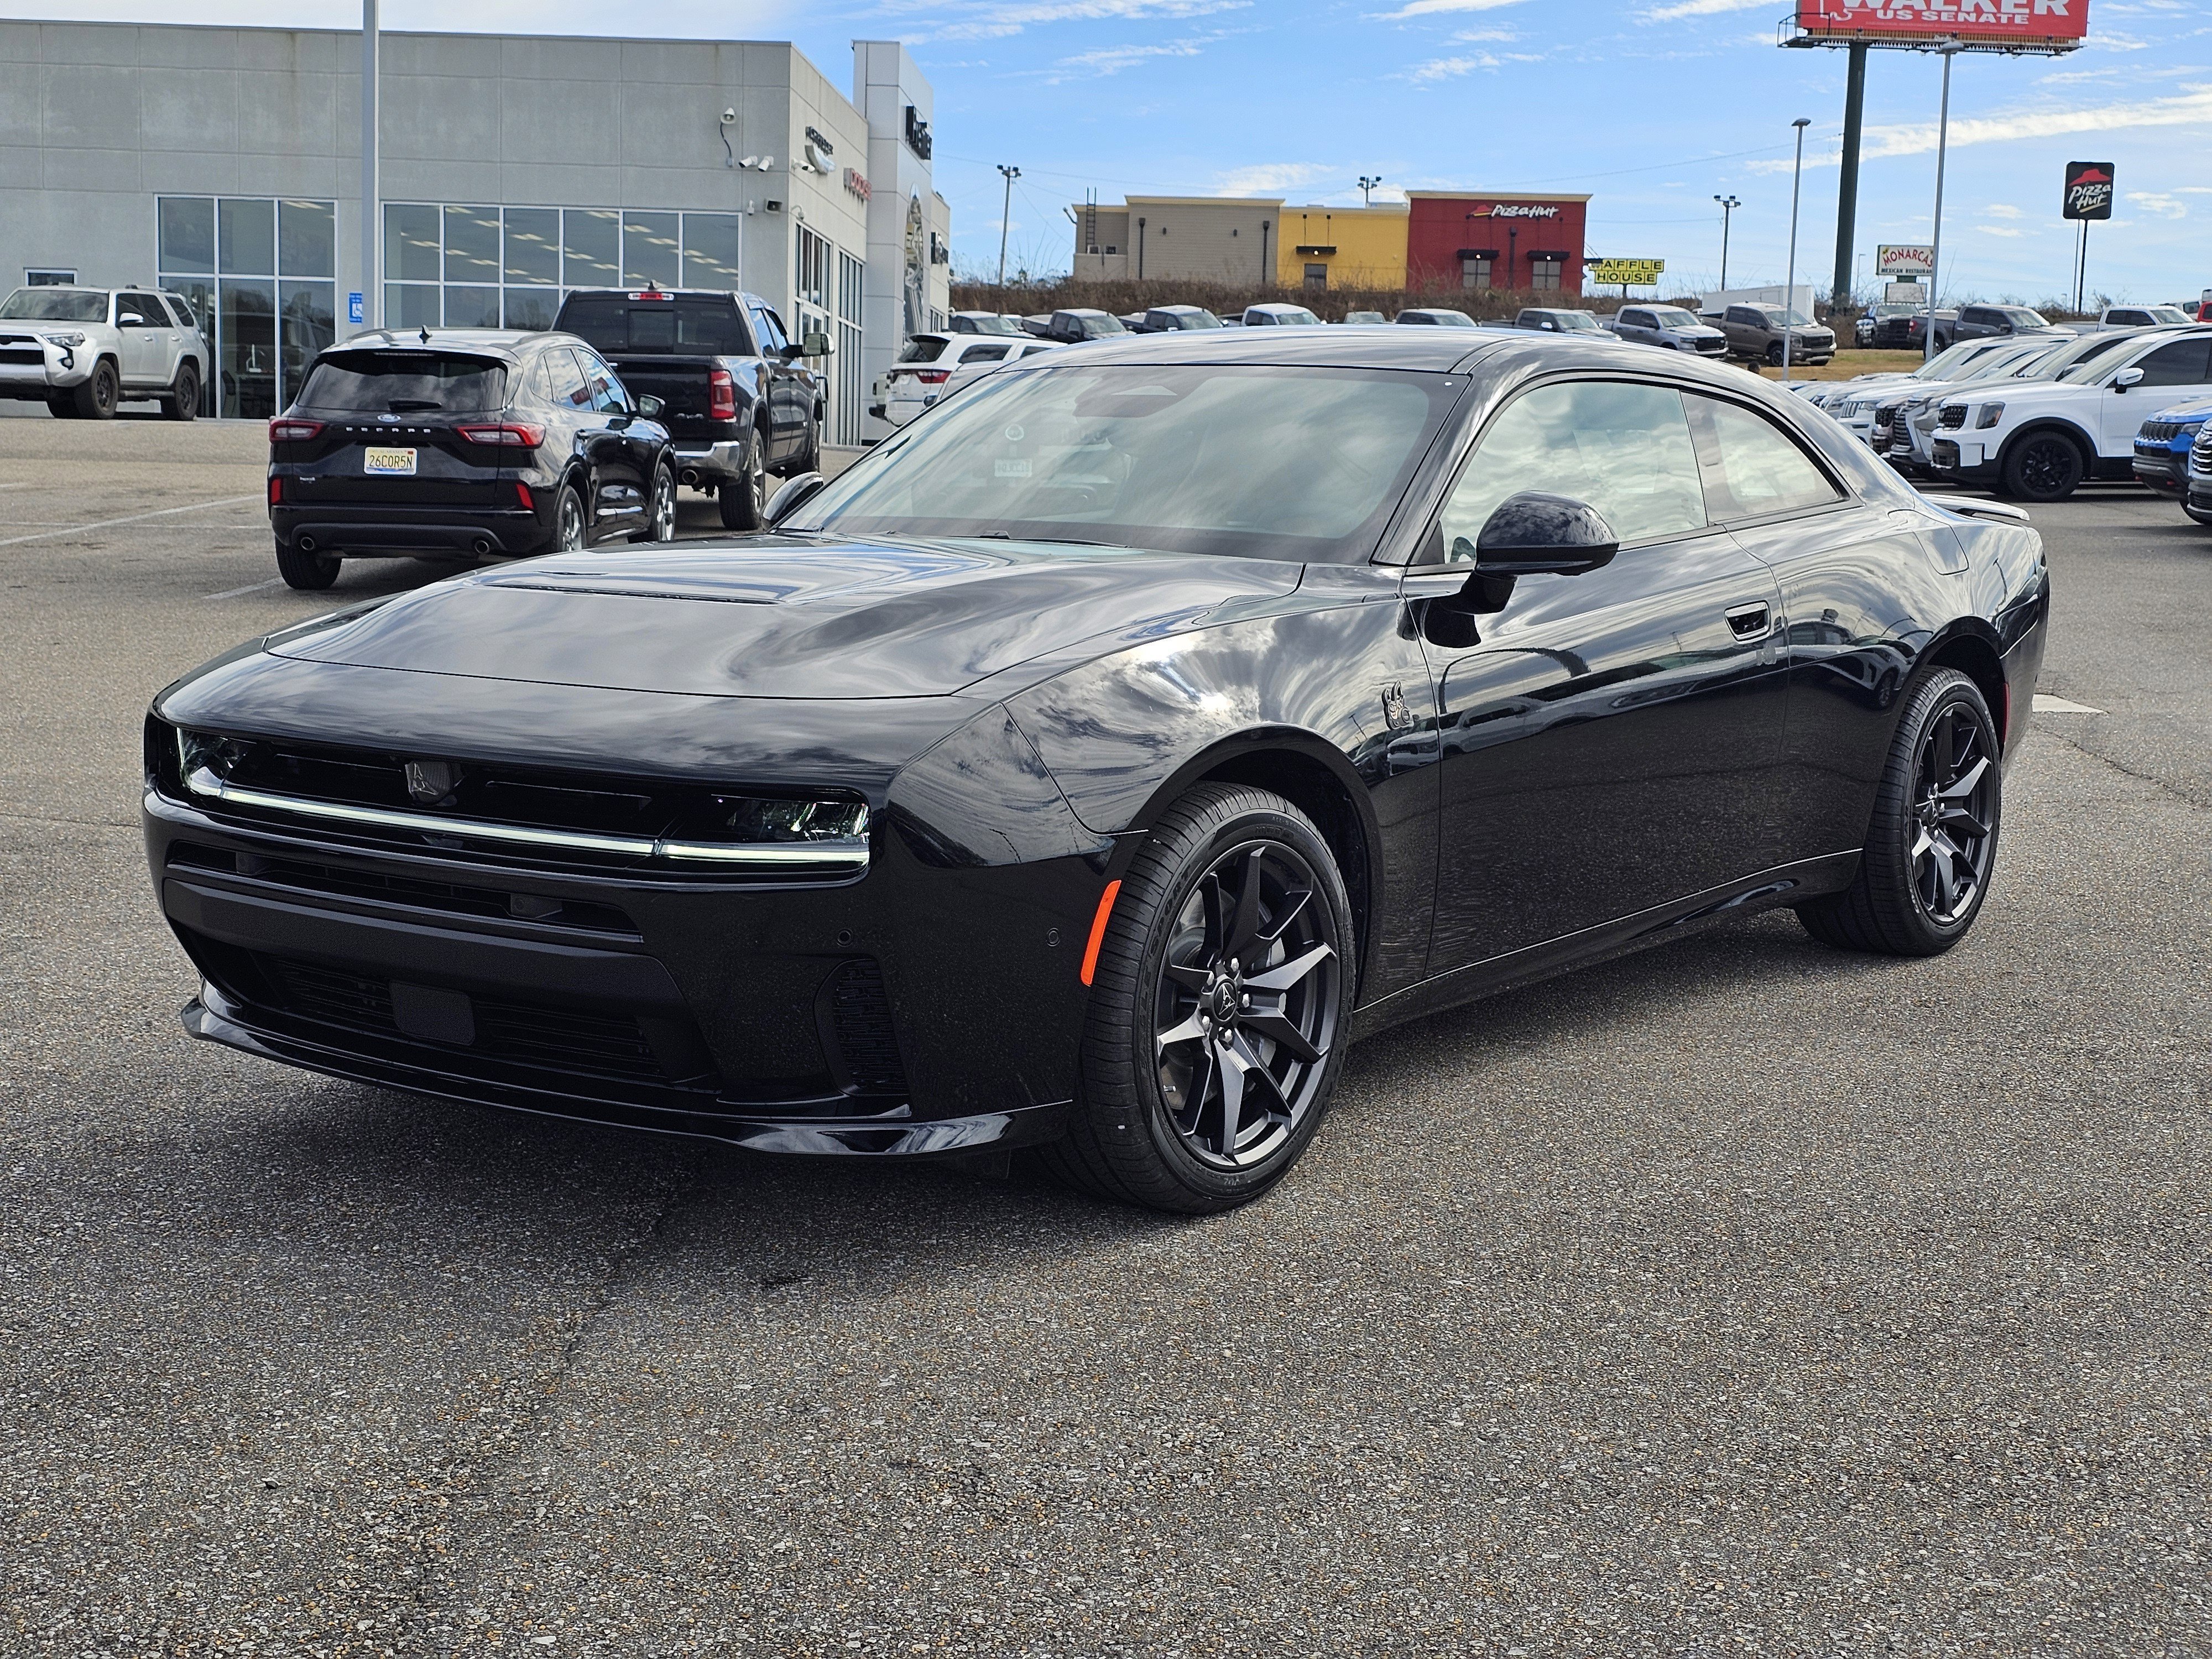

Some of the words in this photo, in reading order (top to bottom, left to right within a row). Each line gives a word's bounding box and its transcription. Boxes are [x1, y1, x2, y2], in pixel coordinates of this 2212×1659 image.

[1843, 0, 2069, 15] WALKER
[1876, 9, 1913, 20] US
[1921, 11, 2029, 24] SENATE
[2068, 182, 2111, 204] Pizza
[2076, 194, 2107, 210] Hut
[1491, 204, 1529, 217] Pizza
[1528, 205, 1559, 218] Hut
[1597, 273, 1655, 282] HOUSE
